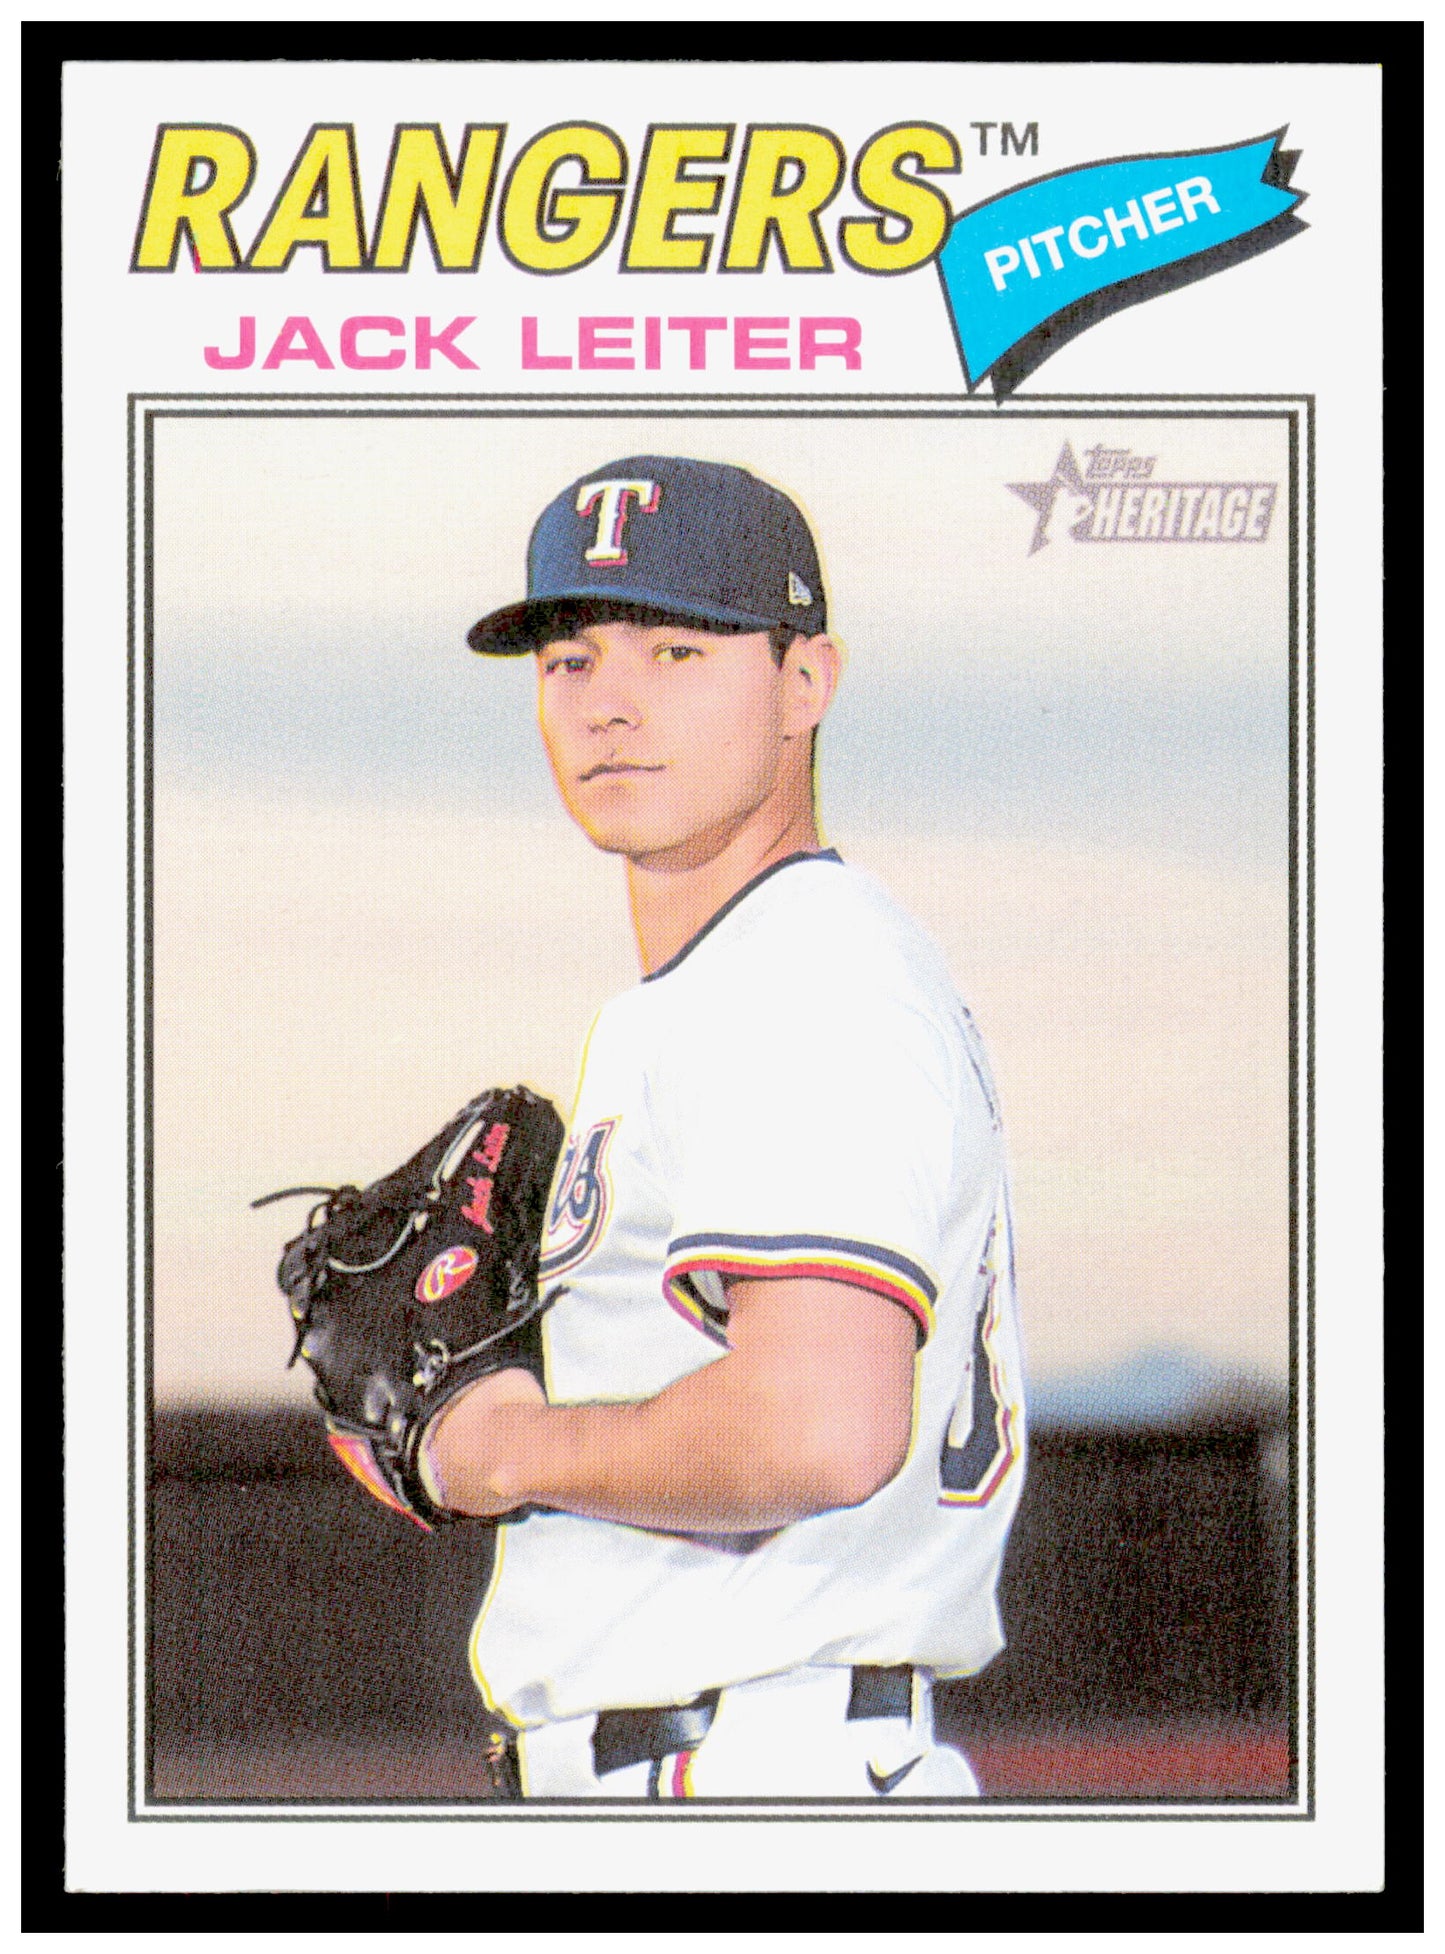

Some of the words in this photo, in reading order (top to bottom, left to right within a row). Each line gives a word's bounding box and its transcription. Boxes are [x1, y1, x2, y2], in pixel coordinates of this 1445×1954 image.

[129, 120, 962, 277] RANGERS
[970, 121, 1039, 156] TM
[984, 175, 1221, 292] PITCHER
[203, 316, 480, 371] JACK
[521, 316, 862, 371] LEITER
[576, 479, 661, 566] T
[1091, 486, 1272, 537] HERITAGE
